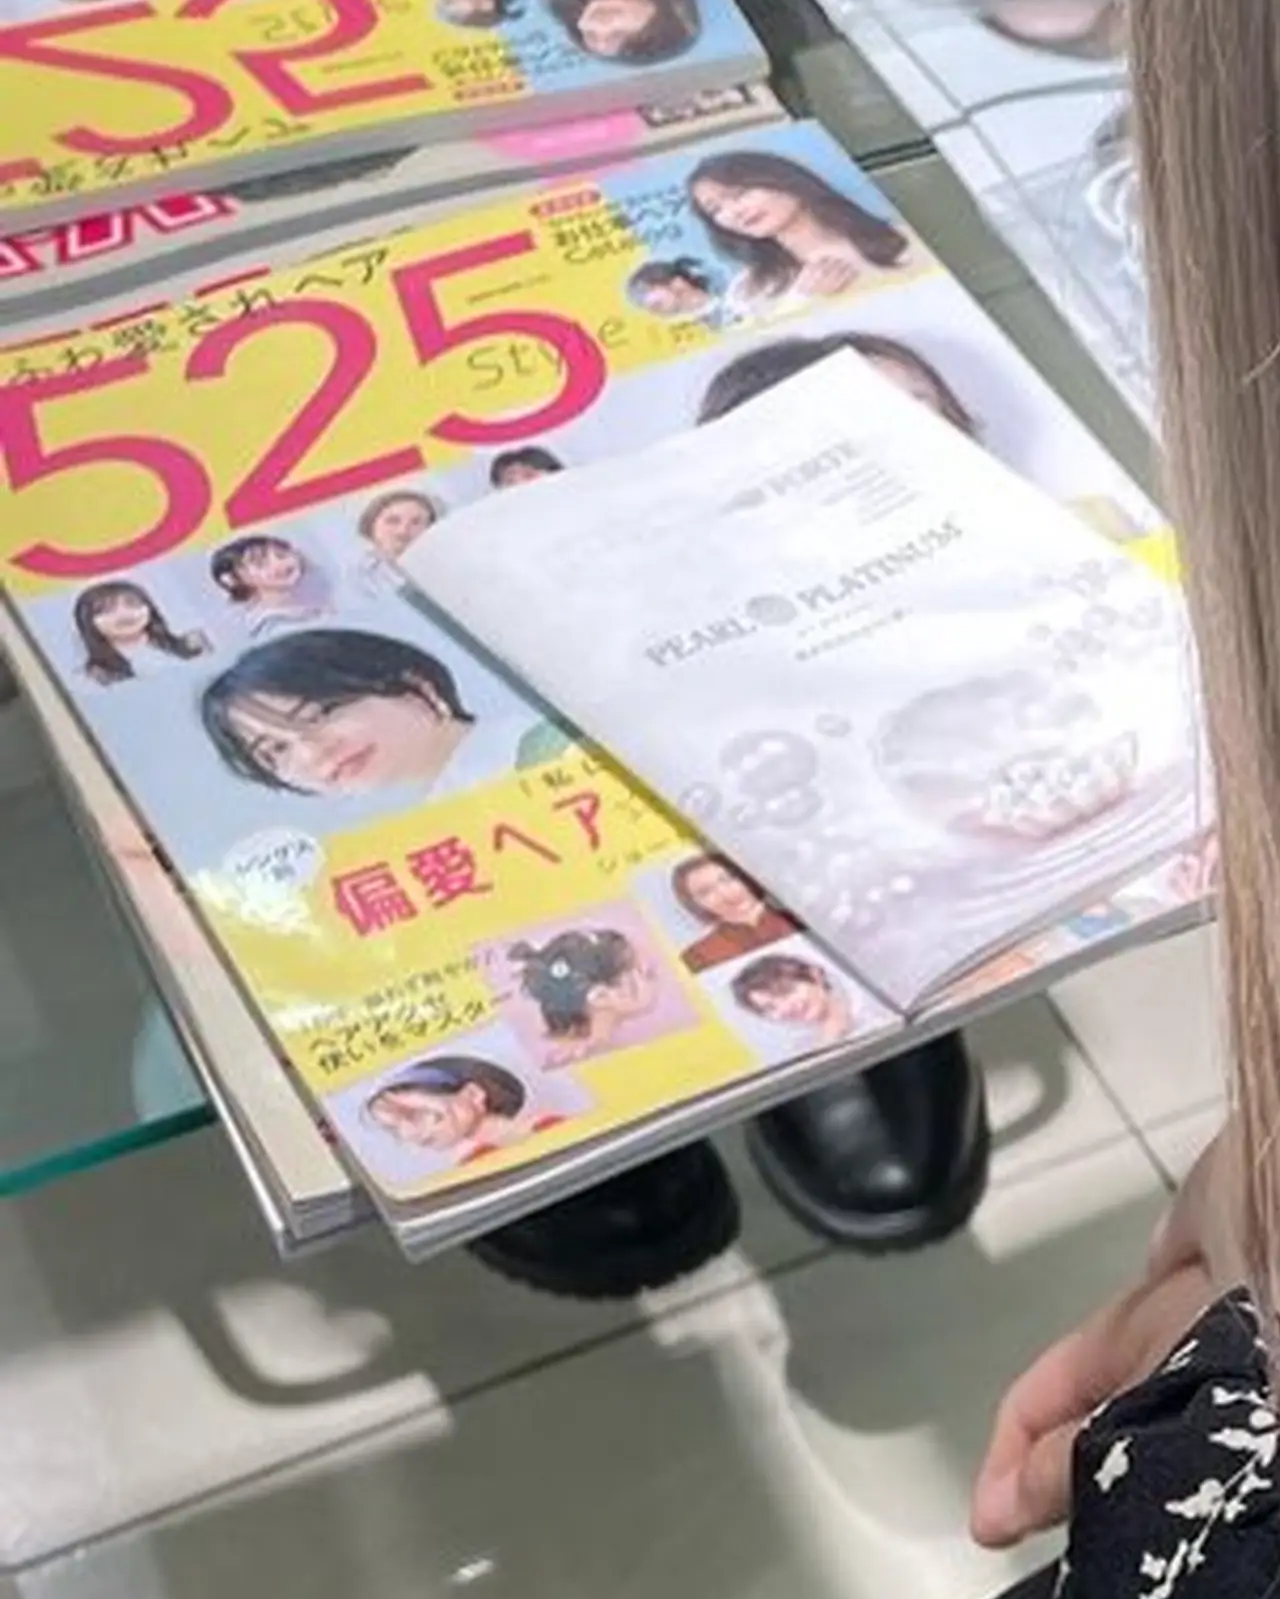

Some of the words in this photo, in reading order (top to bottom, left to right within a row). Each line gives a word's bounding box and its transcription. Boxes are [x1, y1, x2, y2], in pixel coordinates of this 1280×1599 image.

[0, 229, 608, 578] 525
[646, 611, 762, 668] PEARL
[797, 518, 964, 613] PLATINUM
[331, 788, 603, 937] 偏愛ヘア
